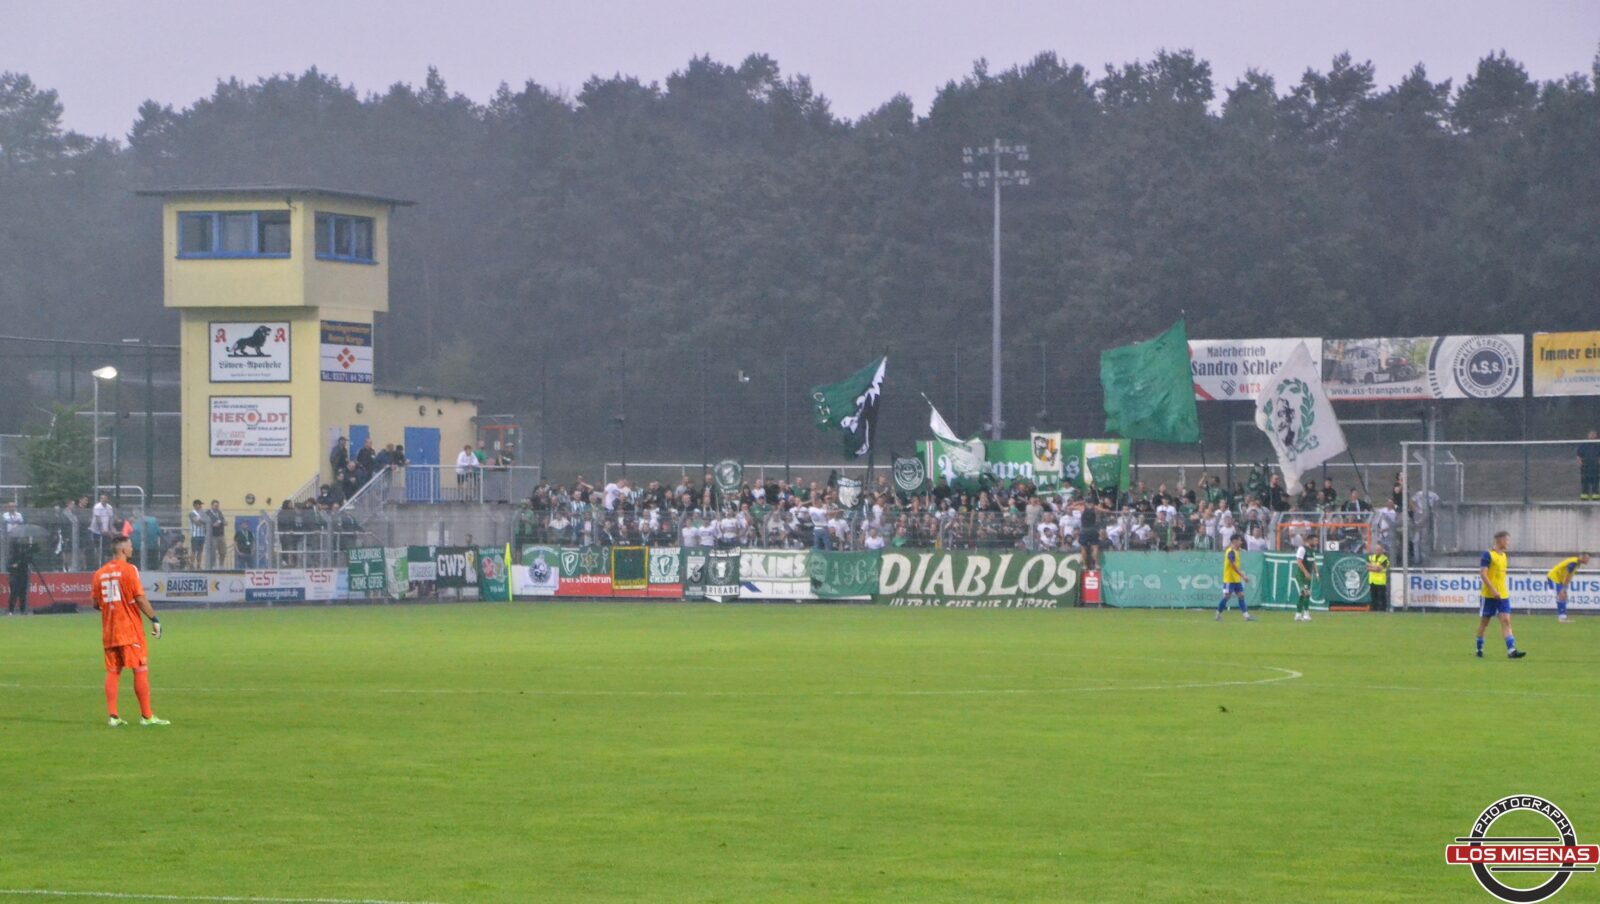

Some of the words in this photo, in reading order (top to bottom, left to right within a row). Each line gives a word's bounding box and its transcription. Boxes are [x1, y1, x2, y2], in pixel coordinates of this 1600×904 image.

[1207, 345, 1266, 358] Malerbetrieb
[1540, 346, 1581, 361] Immer
[1191, 360, 1238, 376] Sandro
[1470, 360, 1502, 375] A.S.S.
[1239, 383, 1262, 394] 0173
[212, 412, 289, 424] HEROLDT
[437, 554, 465, 577] GWP
[740, 553, 807, 578] SKINS
[831, 559, 879, 586] 1964
[560, 574, 612, 583] versicherun
[879, 553, 1082, 596] DIABLOS
[61, 583, 92, 594] Sparkass
[1410, 576, 1482, 591] Reisebü
